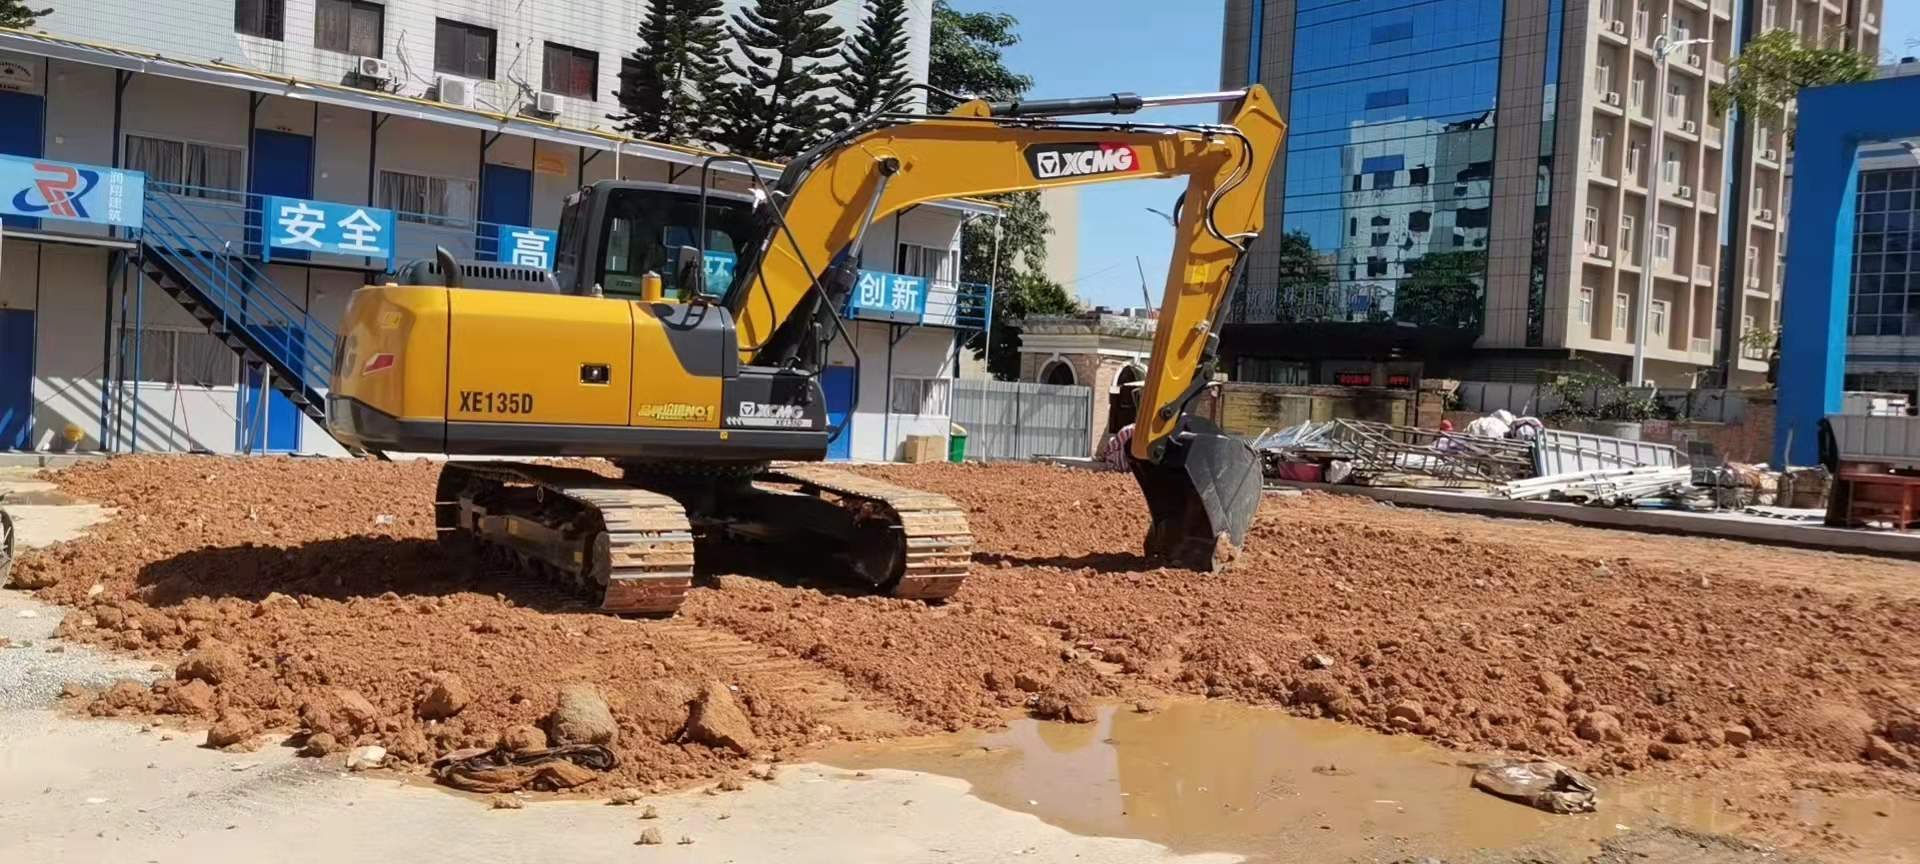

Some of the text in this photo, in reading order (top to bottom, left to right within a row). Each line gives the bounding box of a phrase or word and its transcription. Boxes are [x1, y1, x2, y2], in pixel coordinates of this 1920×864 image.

[1060, 147, 1132, 176] XCMG
[279, 202, 382, 251] 安全
[511, 230, 550, 269] 高
[860, 272, 918, 311] 创新
[459, 391, 533, 414] XE135D
[755, 403, 803, 419] XCMG
